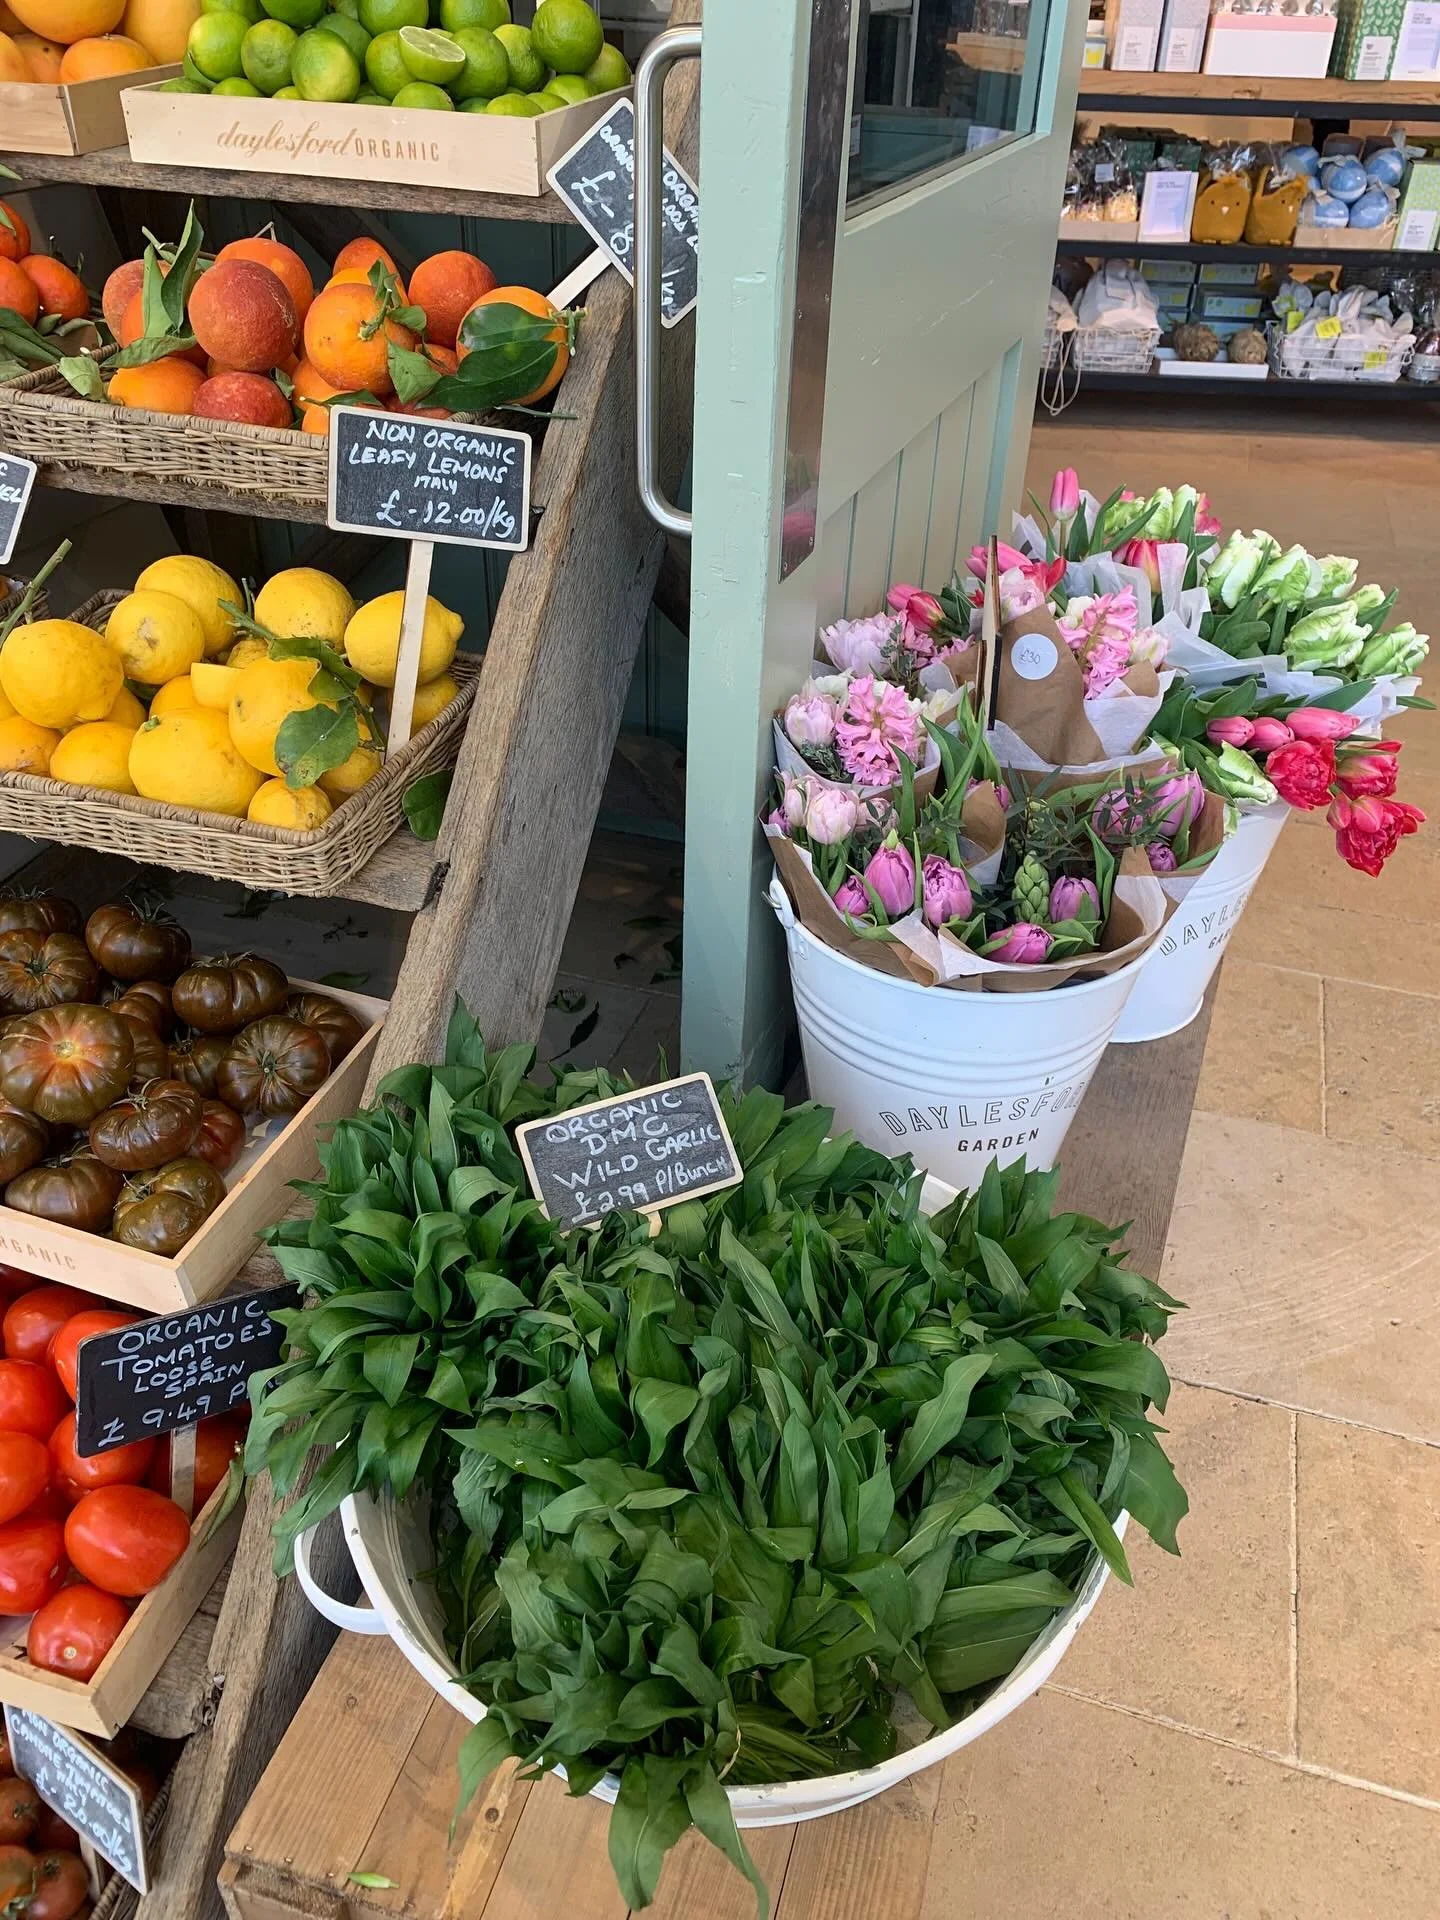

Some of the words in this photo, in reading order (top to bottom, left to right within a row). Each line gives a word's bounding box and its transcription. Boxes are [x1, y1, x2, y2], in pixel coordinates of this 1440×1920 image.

[216, 119, 358, 160] daylesford
[354, 137, 441, 162] ORGANIC
[366, 420, 415, 443] NON
[423, 429, 516, 465] ORGANIC
[414, 475, 458, 495] ITALY
[428, 452, 508, 484] LEMONS
[546, 1093, 682, 1143] ORGANIC
[552, 1154, 639, 1190] WILD
[645, 1123, 721, 1161] GARLIC
[957, 1128, 1039, 1152] GARDEN
[571, 1182, 650, 1224] £2.99
[118, 1300, 264, 1353] ORGANIC
[101, 1318, 272, 1381] TOMATOES
[134, 1355, 215, 1393] LOOSE
[164, 1360, 245, 1399] SPAIN
[142, 1394, 211, 1428] 9.49
